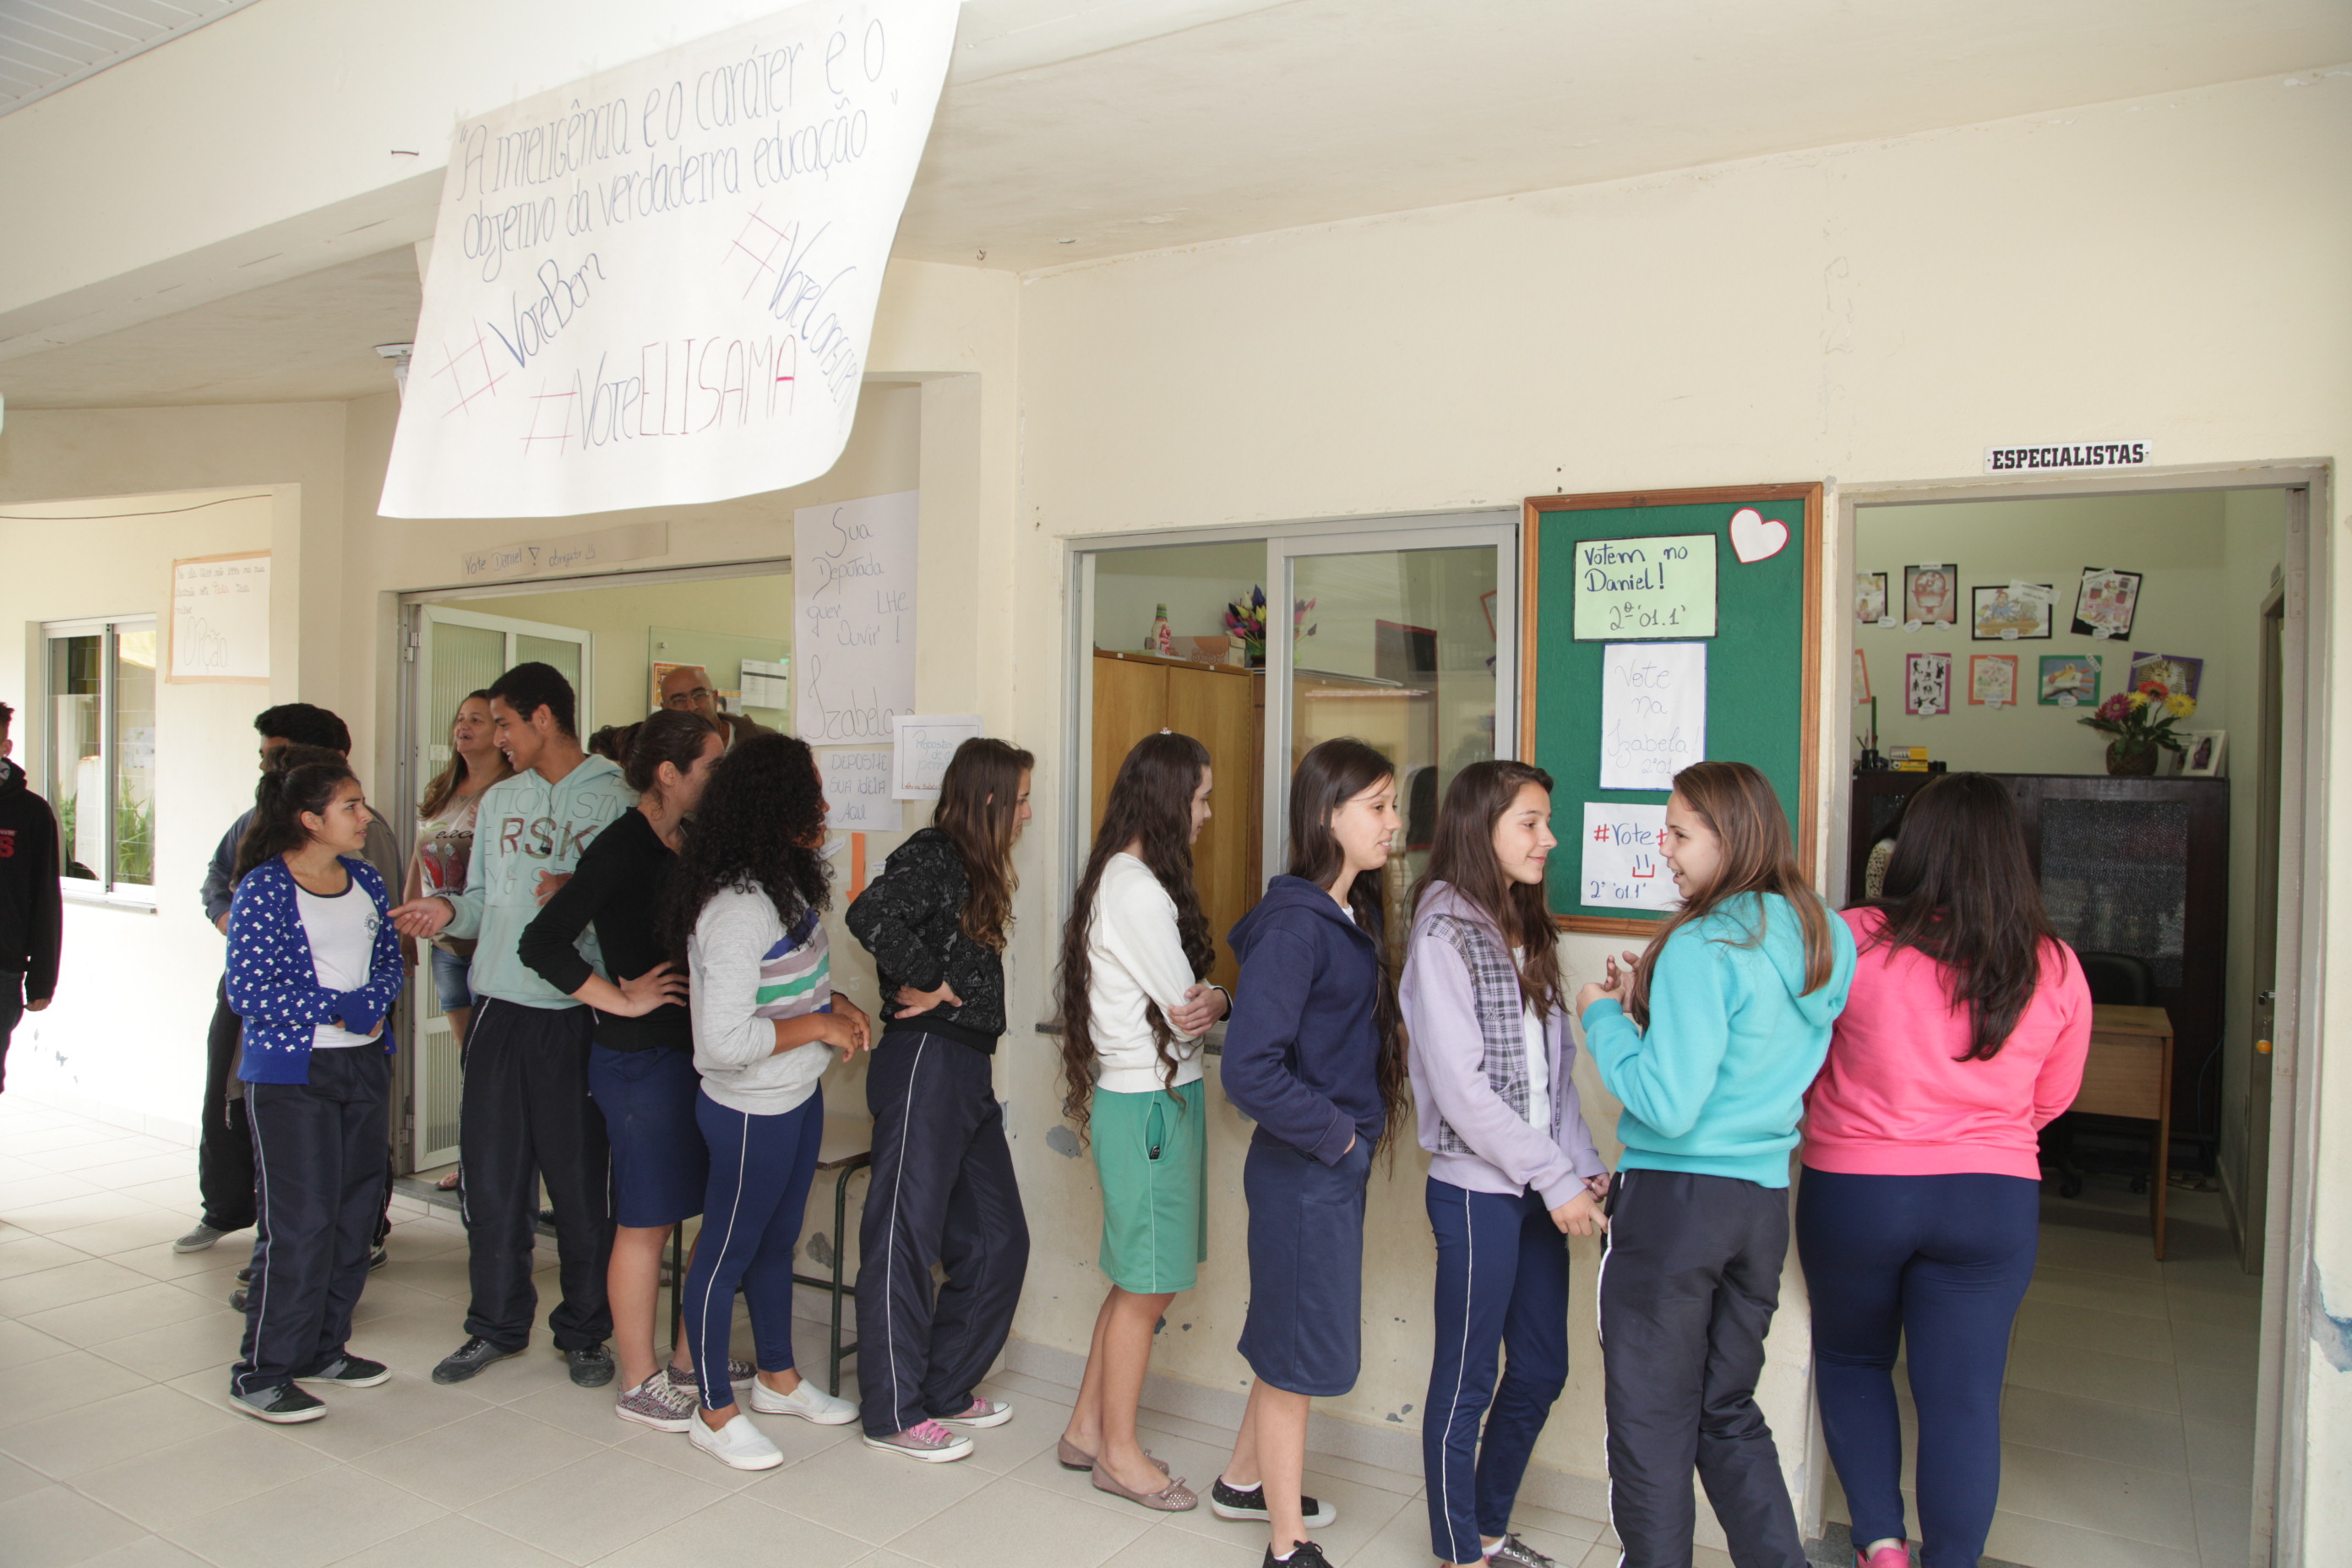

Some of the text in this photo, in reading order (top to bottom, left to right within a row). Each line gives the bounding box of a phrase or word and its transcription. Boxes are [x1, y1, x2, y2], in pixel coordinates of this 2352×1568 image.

[695, 44, 804, 131] caráter
[825, 14, 847, 95] é
[566, 178, 593, 237] da
[598, 144, 741, 226] verdadeira
[1991, 444, 2144, 471] ESPECIALISTAS
[825, 507, 874, 558] Sua
[465, 558, 487, 575] Vote
[1584, 543, 1688, 566] Votem no
[1584, 562, 1664, 592] Daniel!
[1615, 659, 1670, 689] Vote
[1631, 696, 1668, 720] na
[829, 776, 852, 793] SUA
[1593, 822, 1655, 847] #Vote
